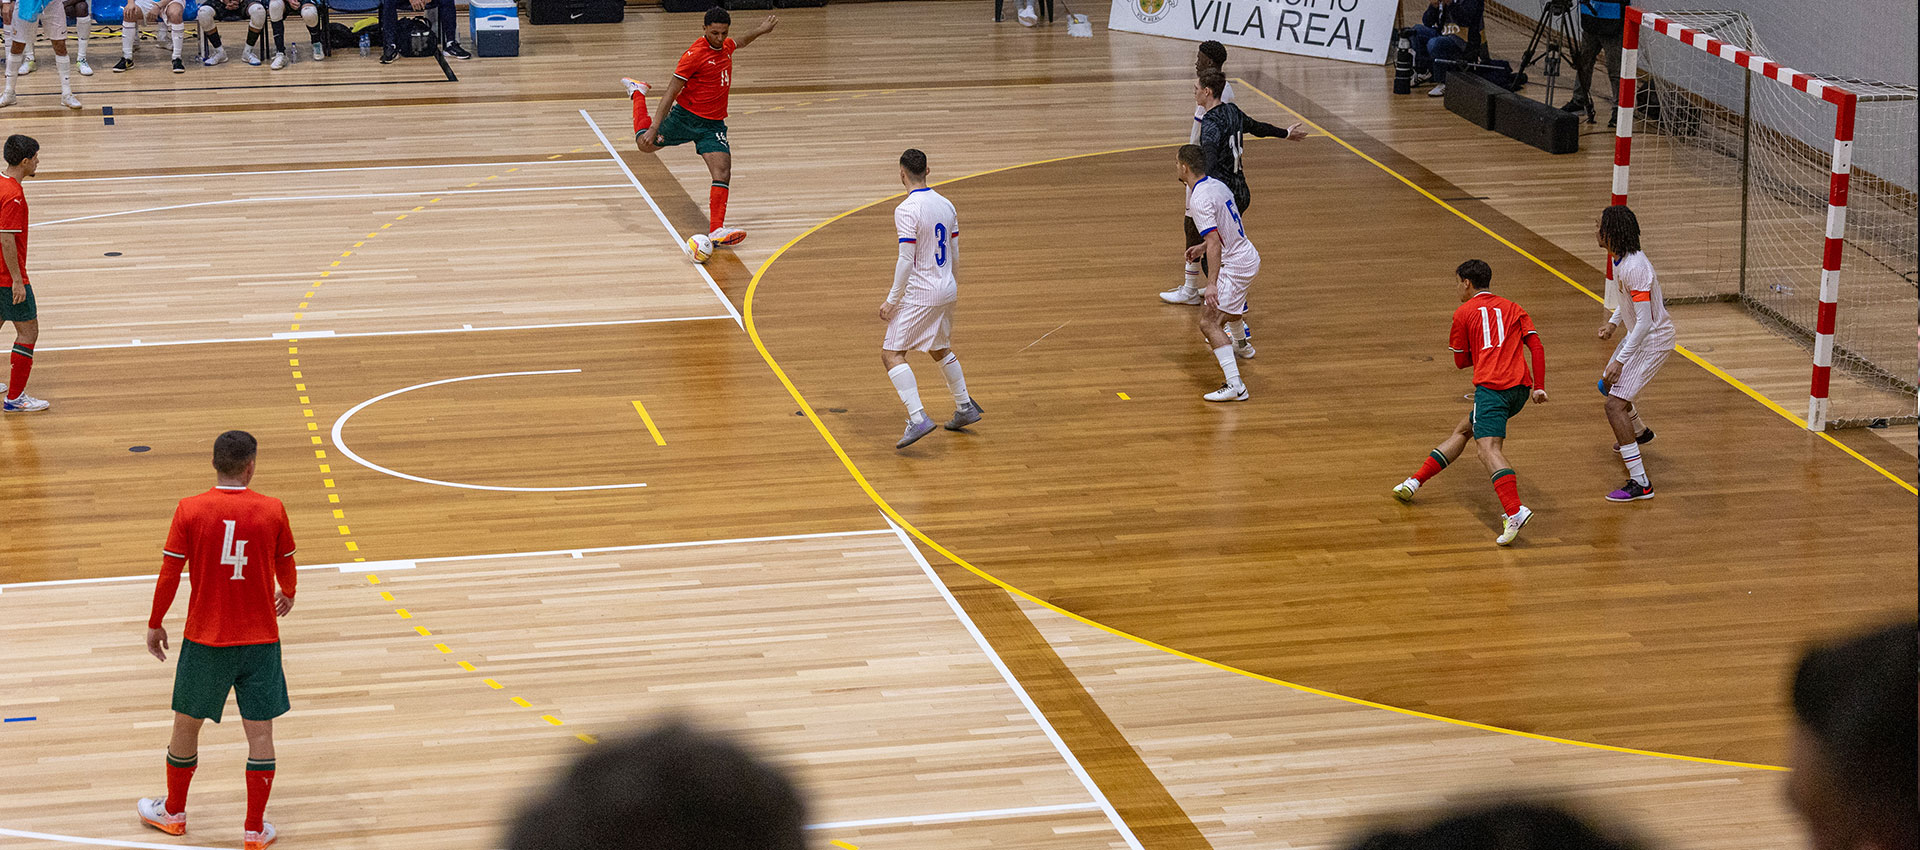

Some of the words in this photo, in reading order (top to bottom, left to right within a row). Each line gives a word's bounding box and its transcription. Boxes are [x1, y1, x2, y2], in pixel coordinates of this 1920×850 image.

[1190, 0, 1265, 39] VILA
[1276, 9, 1373, 53] REAL
[720, 69, 730, 87] 14
[1225, 199, 1245, 238] 5
[934, 222, 947, 268] 3
[1477, 306, 1505, 350] 11
[220, 519, 249, 580] 4
